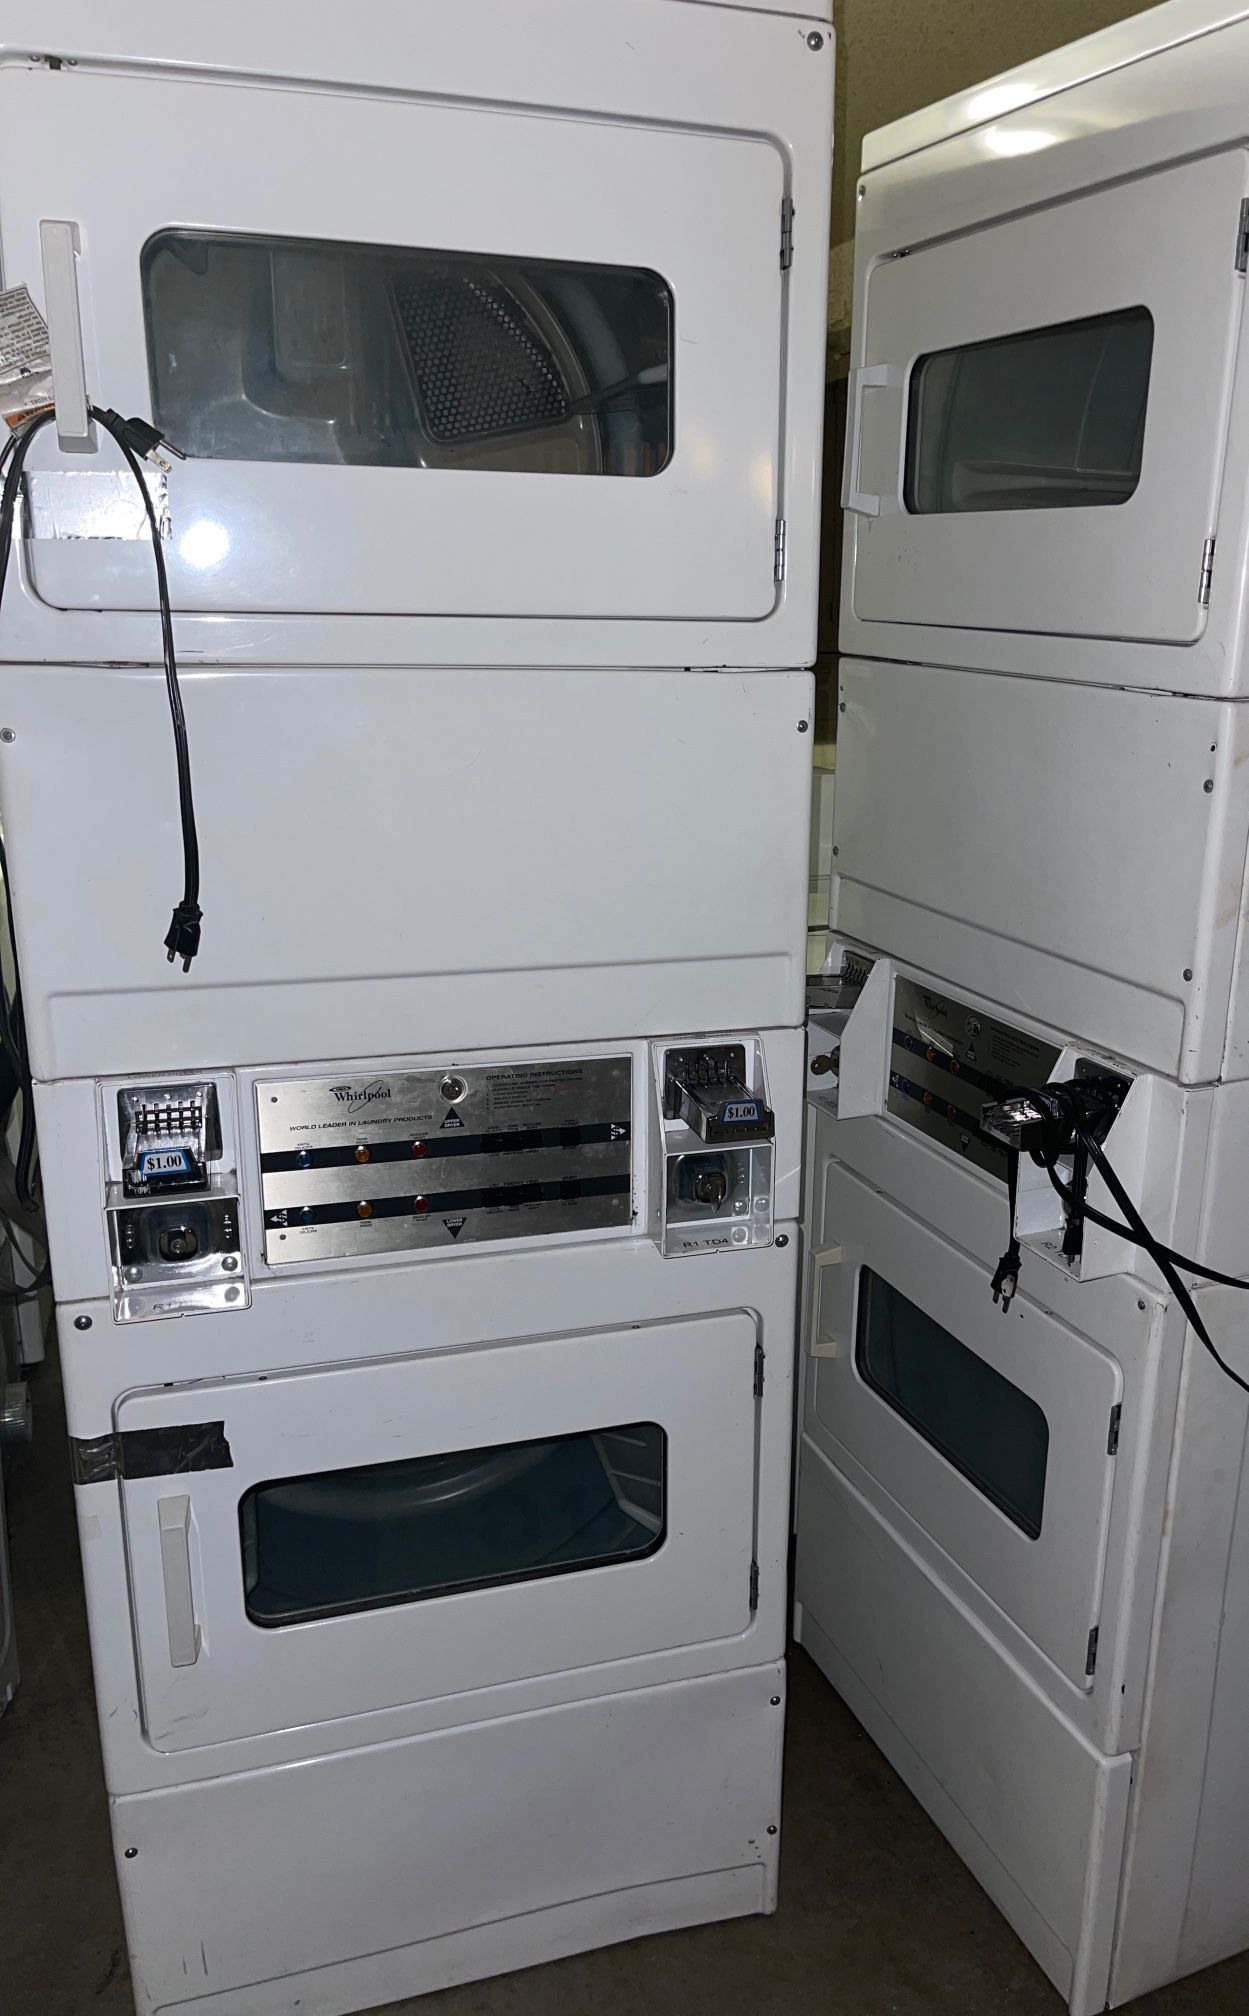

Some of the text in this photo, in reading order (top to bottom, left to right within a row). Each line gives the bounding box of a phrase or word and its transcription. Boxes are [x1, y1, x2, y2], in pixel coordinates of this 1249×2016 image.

[486, 1068, 583, 1081] OPERATING INSTRUCTIONS
[334, 1087, 392, 1104] Whirlpool
[727, 1106, 755, 1119] $1.00
[318, 1121, 347, 1129] LEADER
[357, 1118, 391, 1126] LAUNDRY
[393, 1114, 433, 1123] PRODUCTS
[147, 1155, 182, 1170] $1.00
[682, 1237, 729, 1248] R1 TD4
